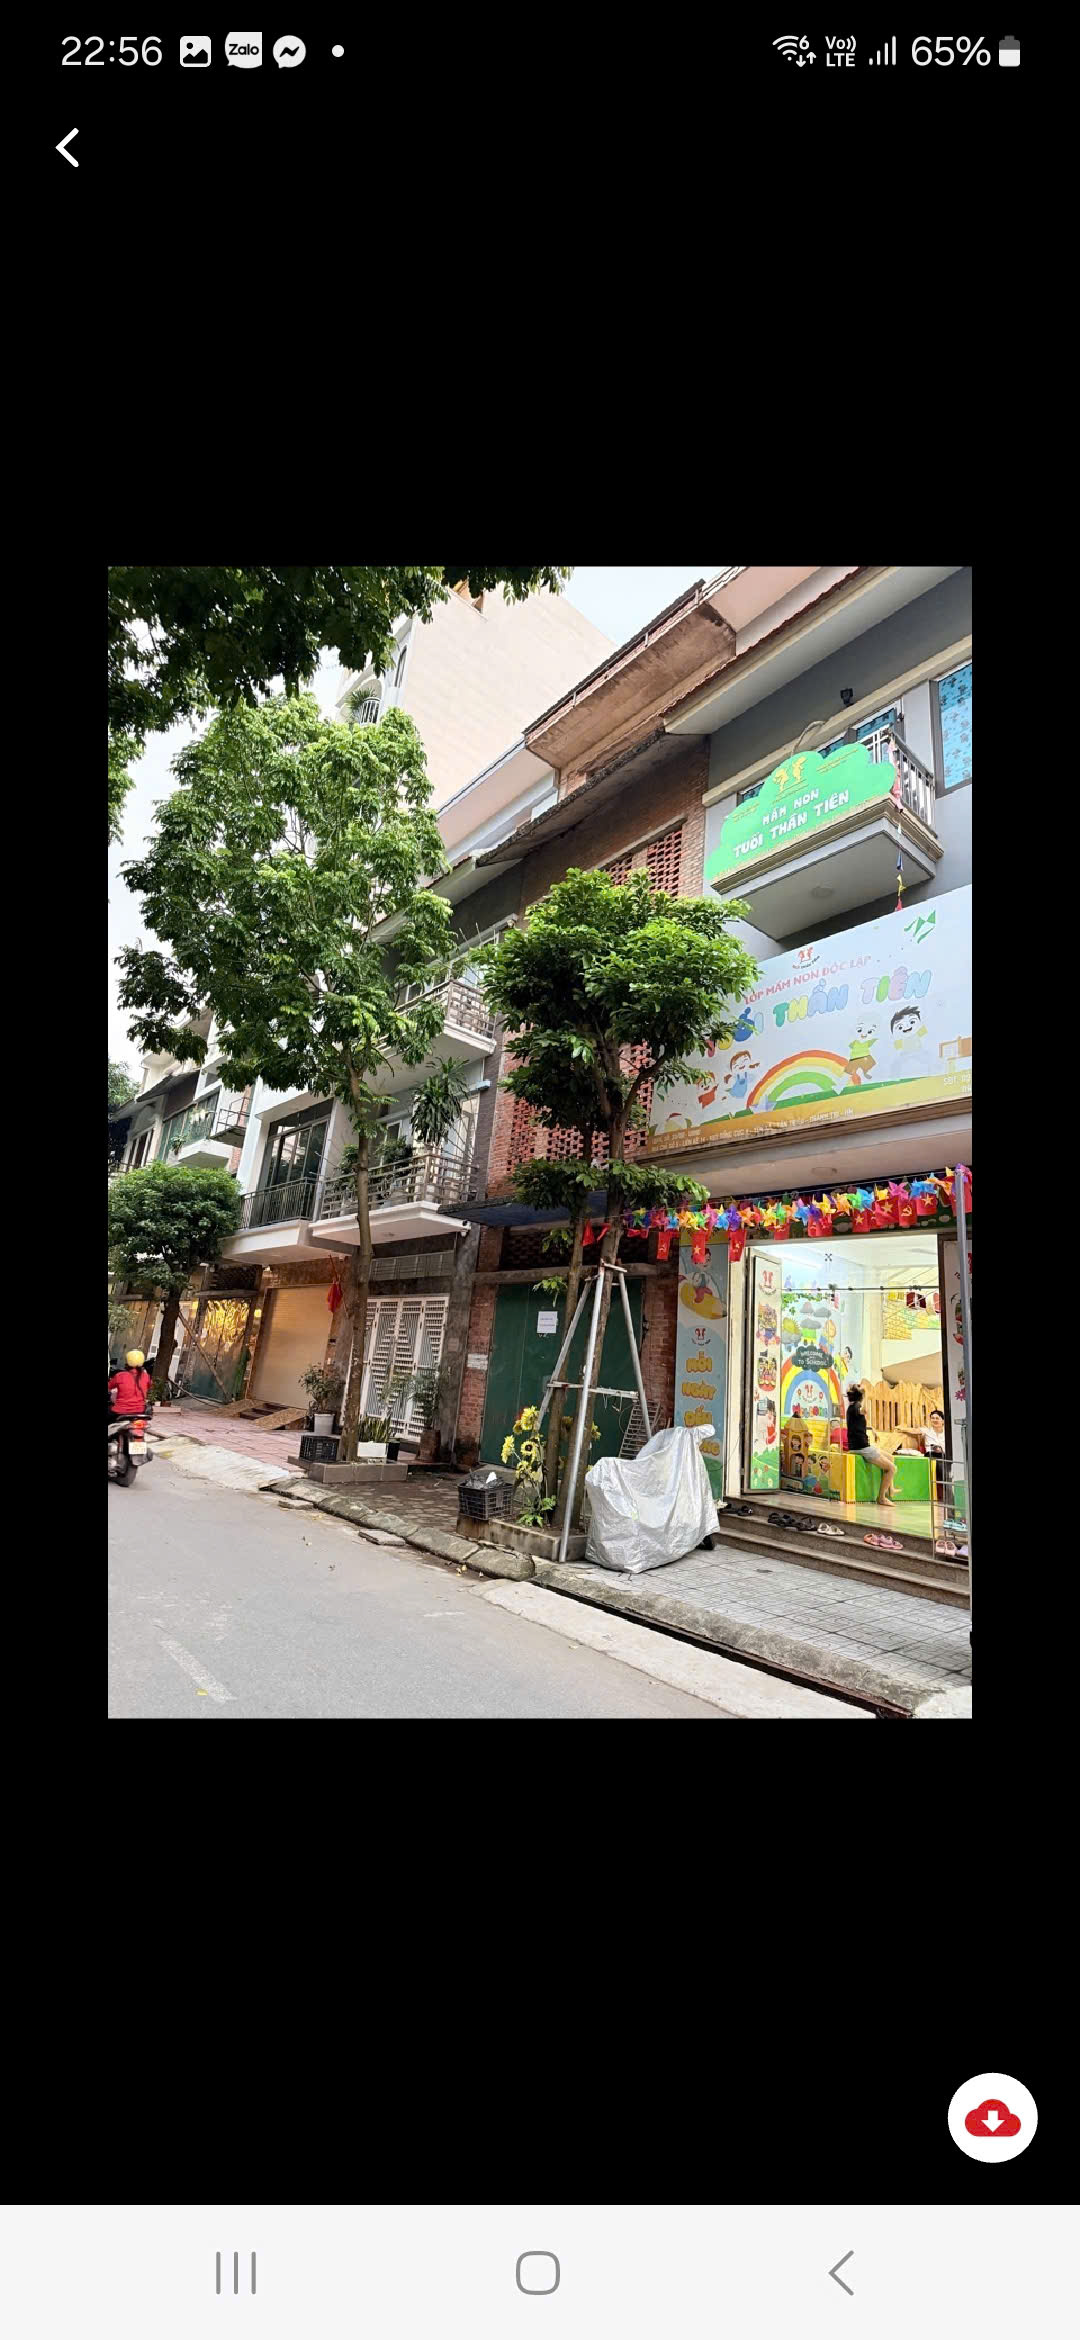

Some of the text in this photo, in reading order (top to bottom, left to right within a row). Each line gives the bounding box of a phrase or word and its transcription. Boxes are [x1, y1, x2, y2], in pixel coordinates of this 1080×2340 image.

[61, 35, 163, 67] 22:56
[228, 43, 260, 57] Zalo
[826, 52, 856, 67] LTE
[911, 35, 992, 67] 65%
[794, 788, 820, 809] NON
[813, 789, 849, 817] TIÊN
[793, 967, 820, 986] NON
[860, 965, 932, 1005] TIÊN
